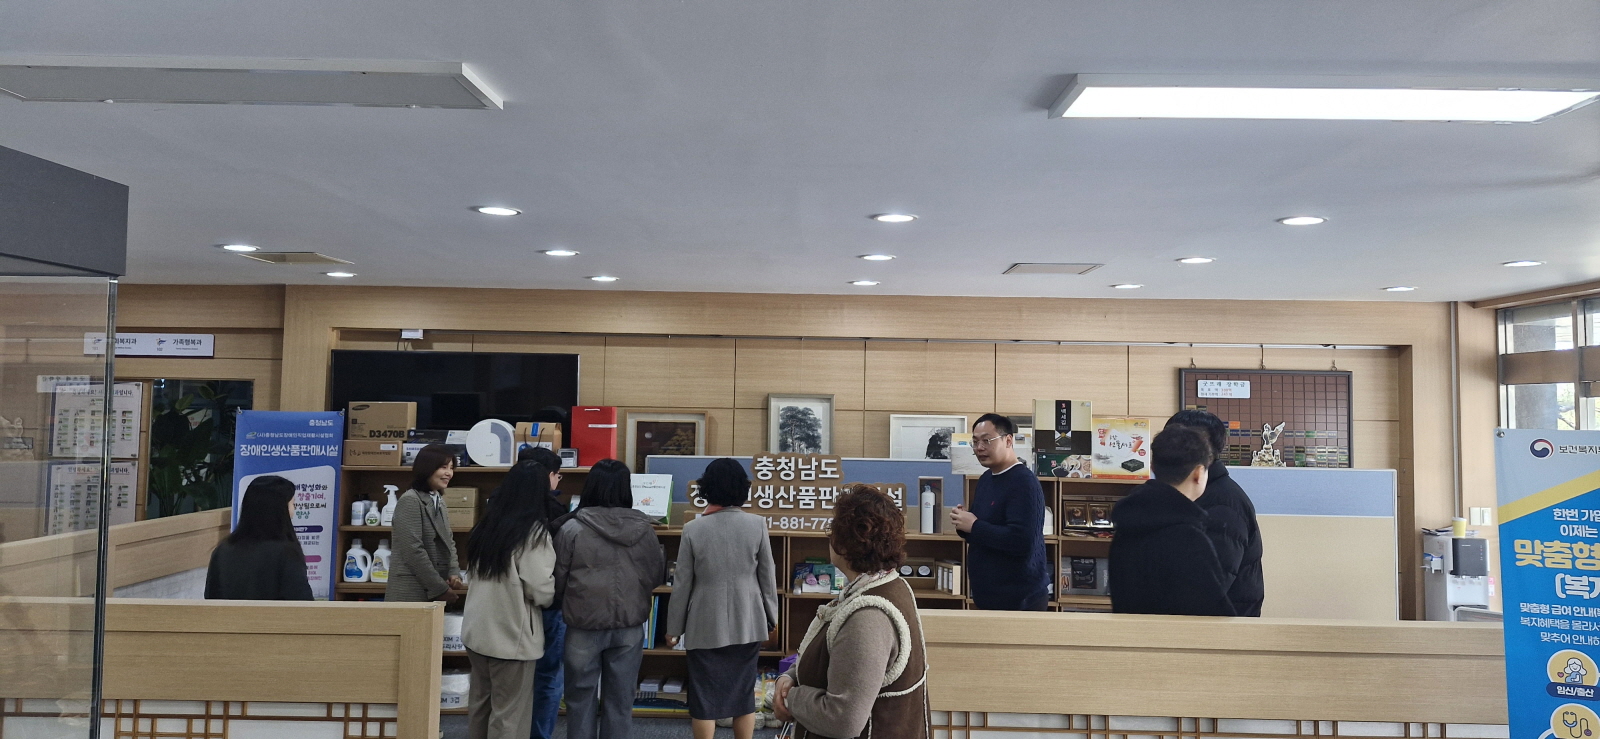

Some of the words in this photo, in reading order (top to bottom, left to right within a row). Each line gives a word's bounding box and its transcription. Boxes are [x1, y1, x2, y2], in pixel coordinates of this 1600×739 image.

[172, 338, 203, 346] 가족행복과
[308, 419, 334, 427] 충청남도
[369, 430, 405, 438] D3470B
[239, 444, 339, 457] 장애인생산품판매시설
[754, 456, 840, 481] 충청남도
[1553, 508, 1579, 521] 한번
[1560, 525, 1599, 538] 이제는
[1513, 539, 1600, 571] 맞춤형
[1519, 602, 1550, 615] 맞춤형
[1551, 605, 1572, 616] 급여
[1520, 616, 1570, 630] 복지혜택을
[1540, 632, 1571, 645] 맞추어
[1556, 685, 1595, 698] 임신/출산
